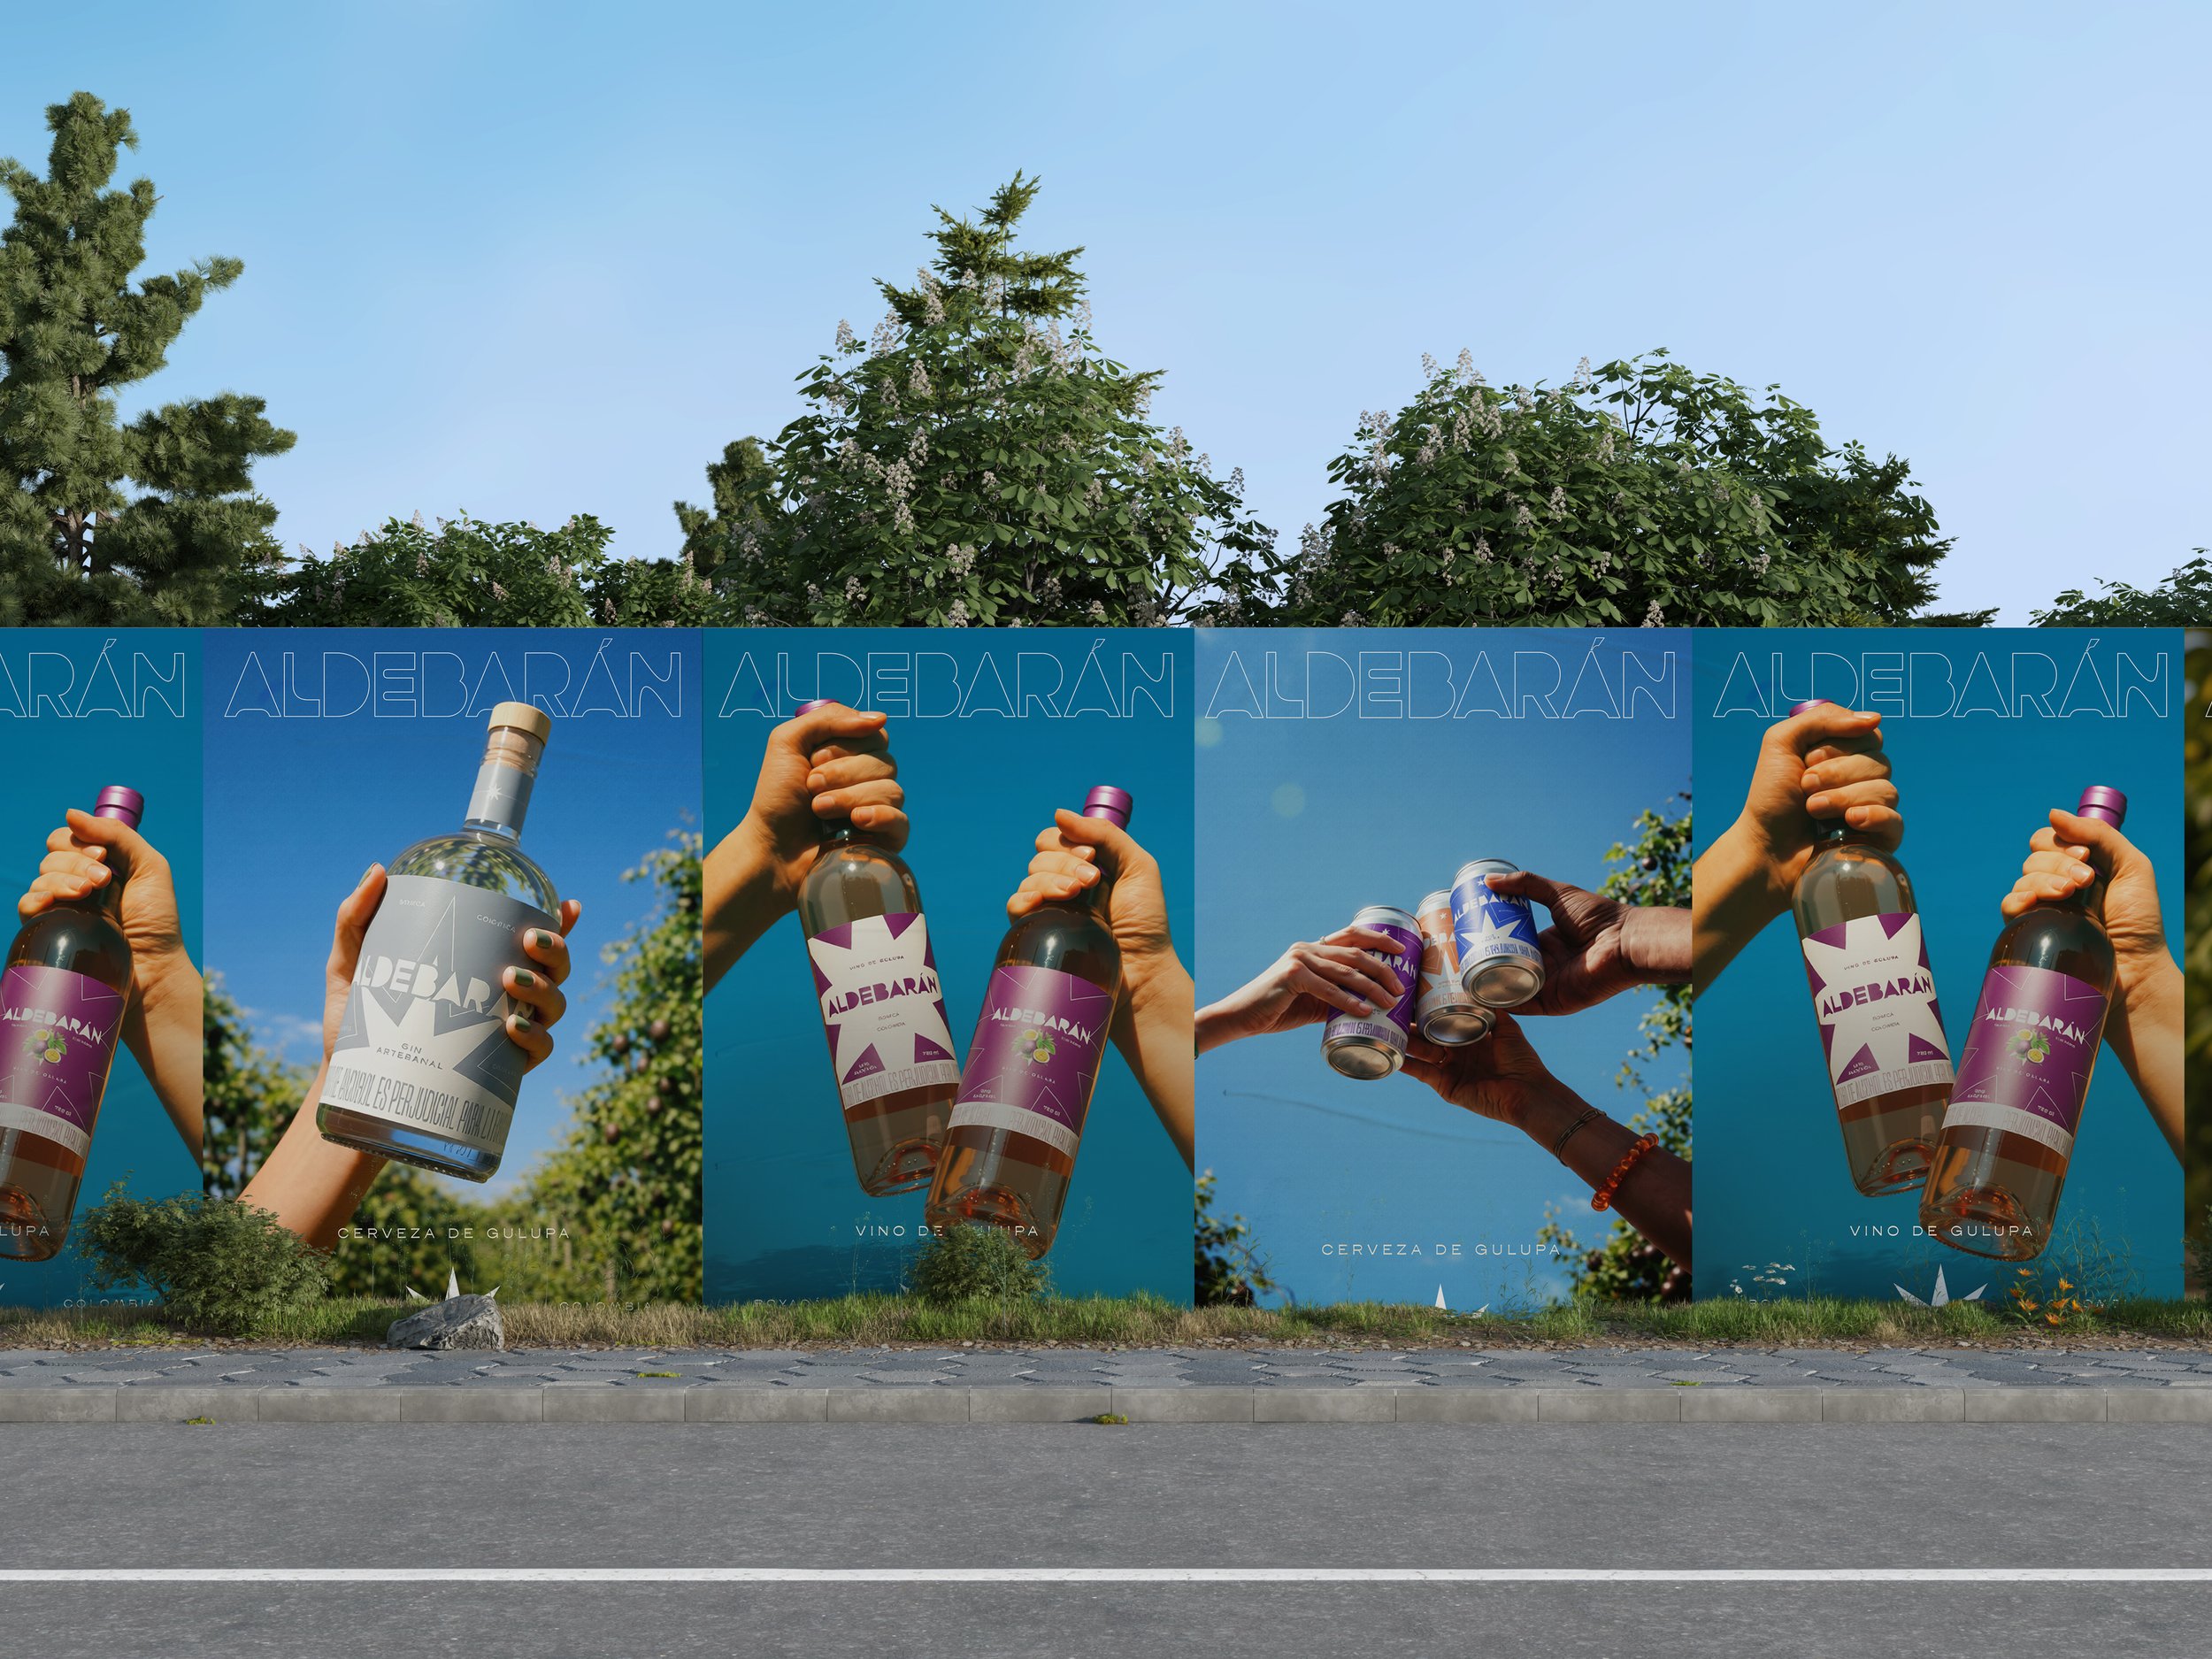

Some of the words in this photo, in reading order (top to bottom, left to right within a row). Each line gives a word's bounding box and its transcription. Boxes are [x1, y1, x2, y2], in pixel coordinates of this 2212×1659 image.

[1204, 636, 1677, 720] ALDEBARÁN
[829, 972, 939, 1018] ALDEBARÁN
[1823, 972, 1932, 1018] ALDEBARÁN
[2, 1005, 103, 1046] ALDEBARÁN
[991, 1005, 1091, 1046] ALDEBARÁN
[1985, 1005, 2086, 1046] ALDEBARÁN
[401, 1042, 422, 1055] GIN
[373, 1076, 392, 1111] ES
[337, 1227, 435, 1240] CERVEZA
[449, 1227, 473, 1239] DE
[487, 1227, 570, 1240] GULUPA
[855, 1225, 905, 1237] VINO
[918, 1225, 943, 1237] DE
[1321, 1243, 1422, 1256] CERVEZA
[1435, 1243, 1462, 1256] DE
[1475, 1243, 1561, 1256] GULUPA
[1849, 1225, 1900, 1237] VINO
[1912, 1225, 1938, 1237] DE
[1950, 1225, 2032, 1237] GULUPA
